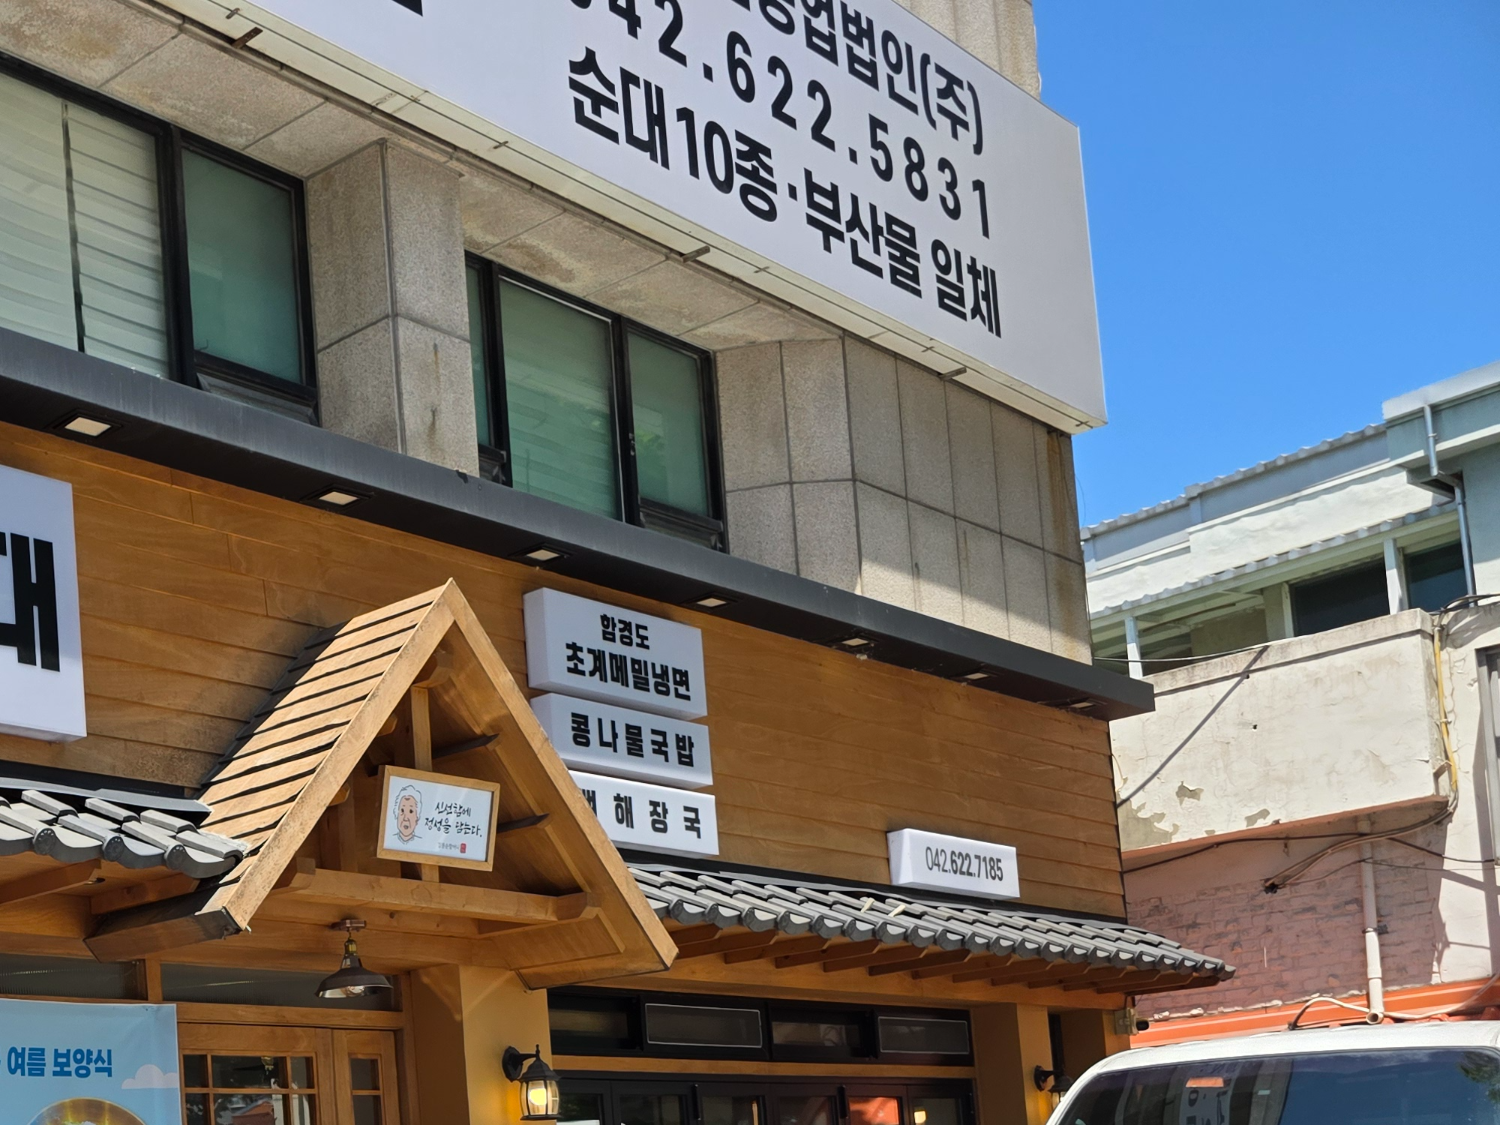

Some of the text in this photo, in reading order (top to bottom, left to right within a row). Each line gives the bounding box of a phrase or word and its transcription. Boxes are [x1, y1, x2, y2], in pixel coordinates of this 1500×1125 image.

[730, 0, 983, 155] 업법인(주)
[570, 0, 990, 238] 42.622.5831
[931, 239, 1002, 339] 일체
[600, 613, 650, 650] 함경도
[565, 642, 691, 701] 초계메밀냉면
[571, 712, 695, 767] 콩나물국밥
[925, 846, 1003, 881] 042.622.7185
[7, 1046, 46, 1077] 여름
[52, 1048, 113, 1078] 보양식
